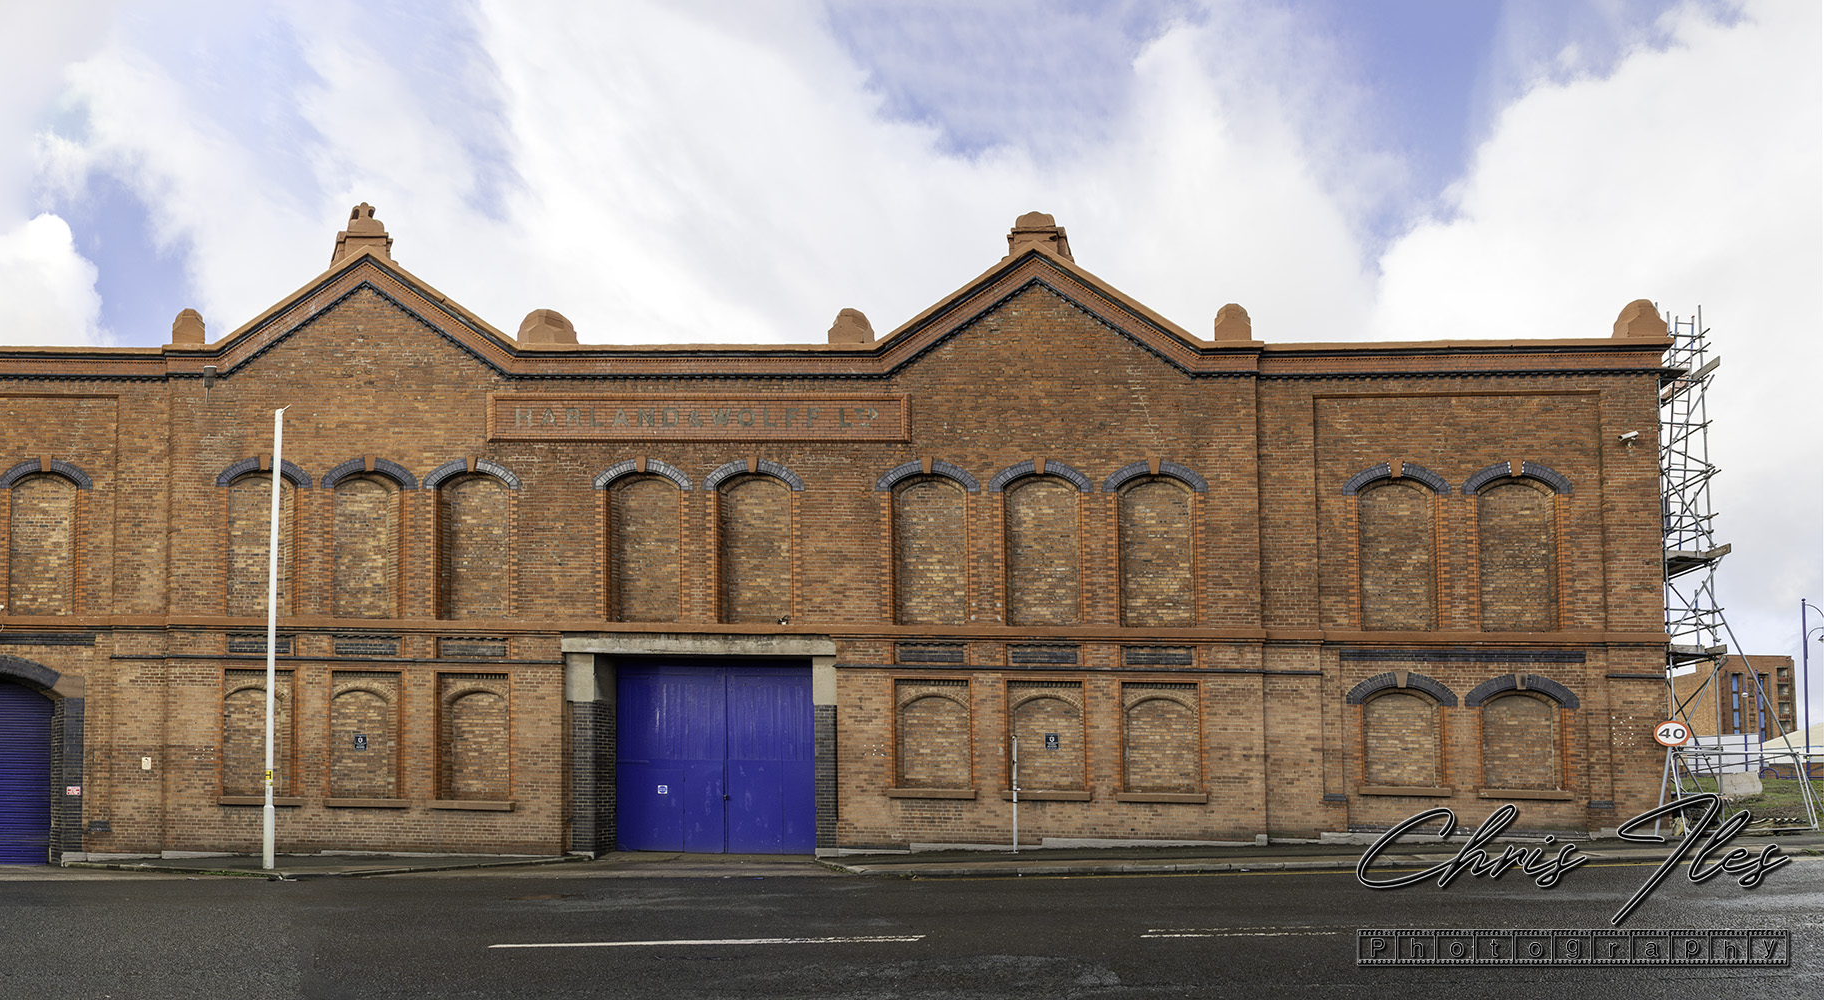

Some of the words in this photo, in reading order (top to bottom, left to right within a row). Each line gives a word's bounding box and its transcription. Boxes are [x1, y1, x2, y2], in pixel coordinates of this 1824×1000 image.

[515, 408, 679, 427] HARLAND
[689, 410, 703, 427] &
[709, 408, 822, 427] WOLFF
[1658, 728, 1685, 739] 40
